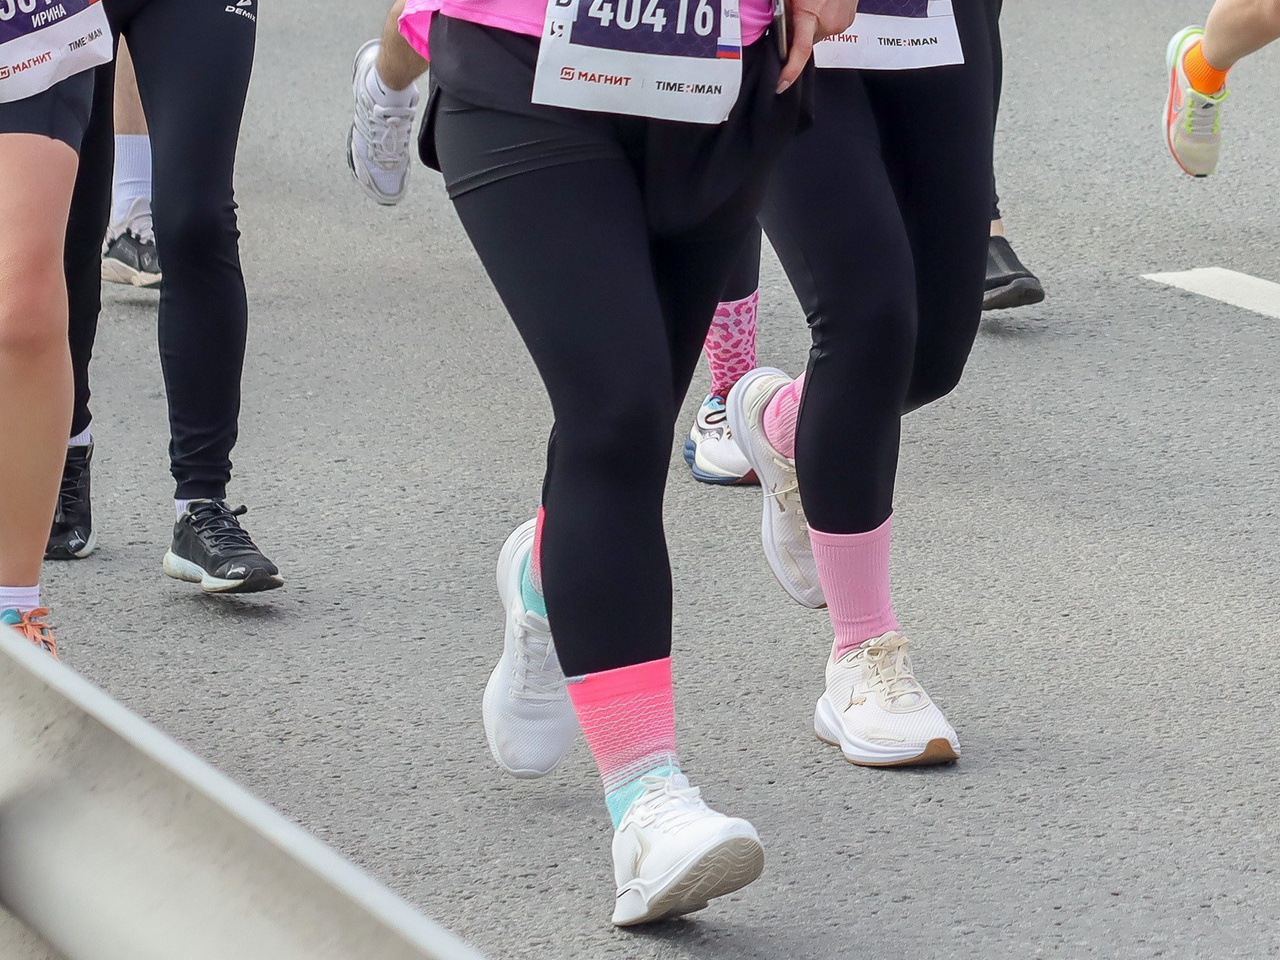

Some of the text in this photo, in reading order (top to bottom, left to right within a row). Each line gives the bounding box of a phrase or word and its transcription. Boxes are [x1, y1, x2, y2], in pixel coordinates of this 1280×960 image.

[31, 3, 67, 28] ИРИНА
[225, 5, 256, 22] DEMIX
[821, 34, 858, 43] АГНИТ
[12, 52, 52, 74] МАГНИТ
[577, 71, 632, 86] МАГНИТ
